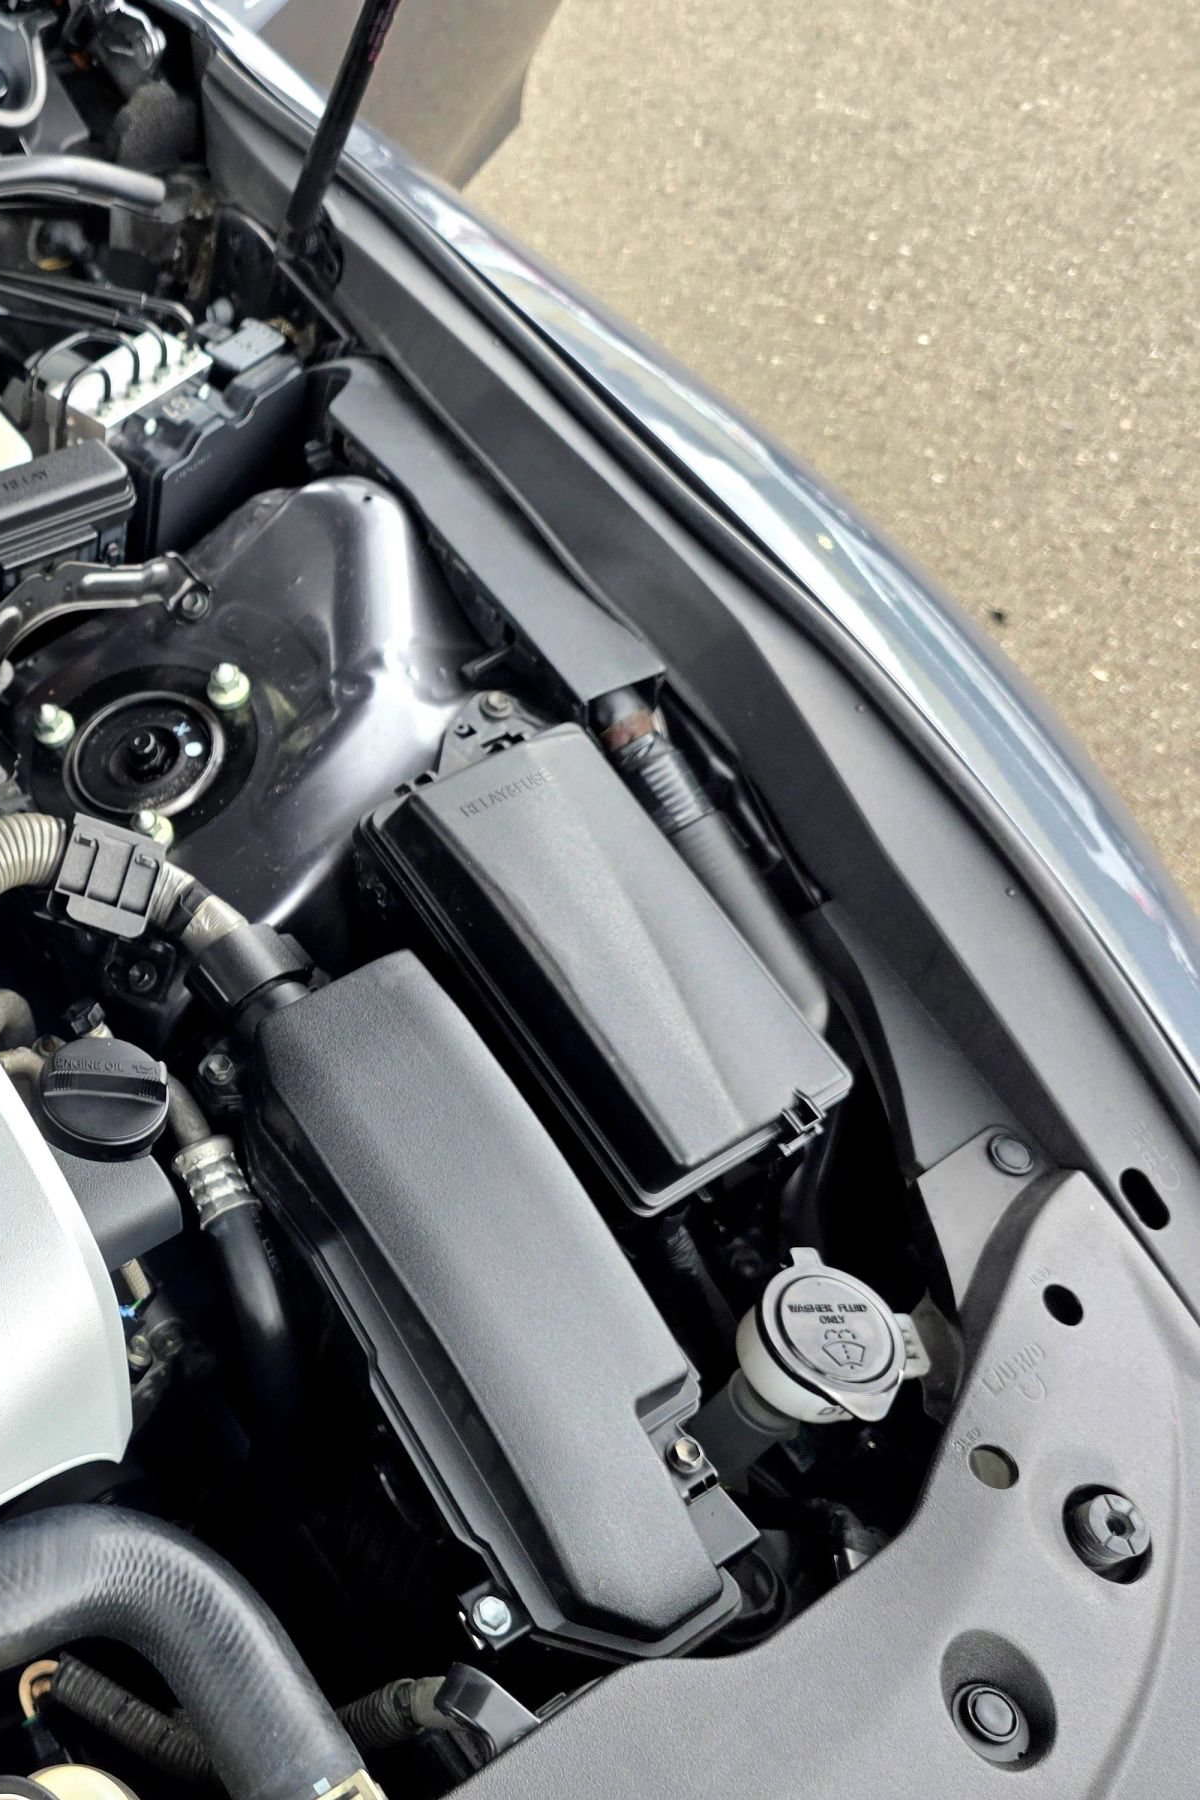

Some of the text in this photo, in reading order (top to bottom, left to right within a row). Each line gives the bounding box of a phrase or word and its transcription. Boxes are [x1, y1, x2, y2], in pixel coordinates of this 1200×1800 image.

[55, 1058, 124, 1073] ENGINE OIL
[787, 1304, 868, 1313] WASHER FLUID
[818, 1315, 846, 1324] ONLY
